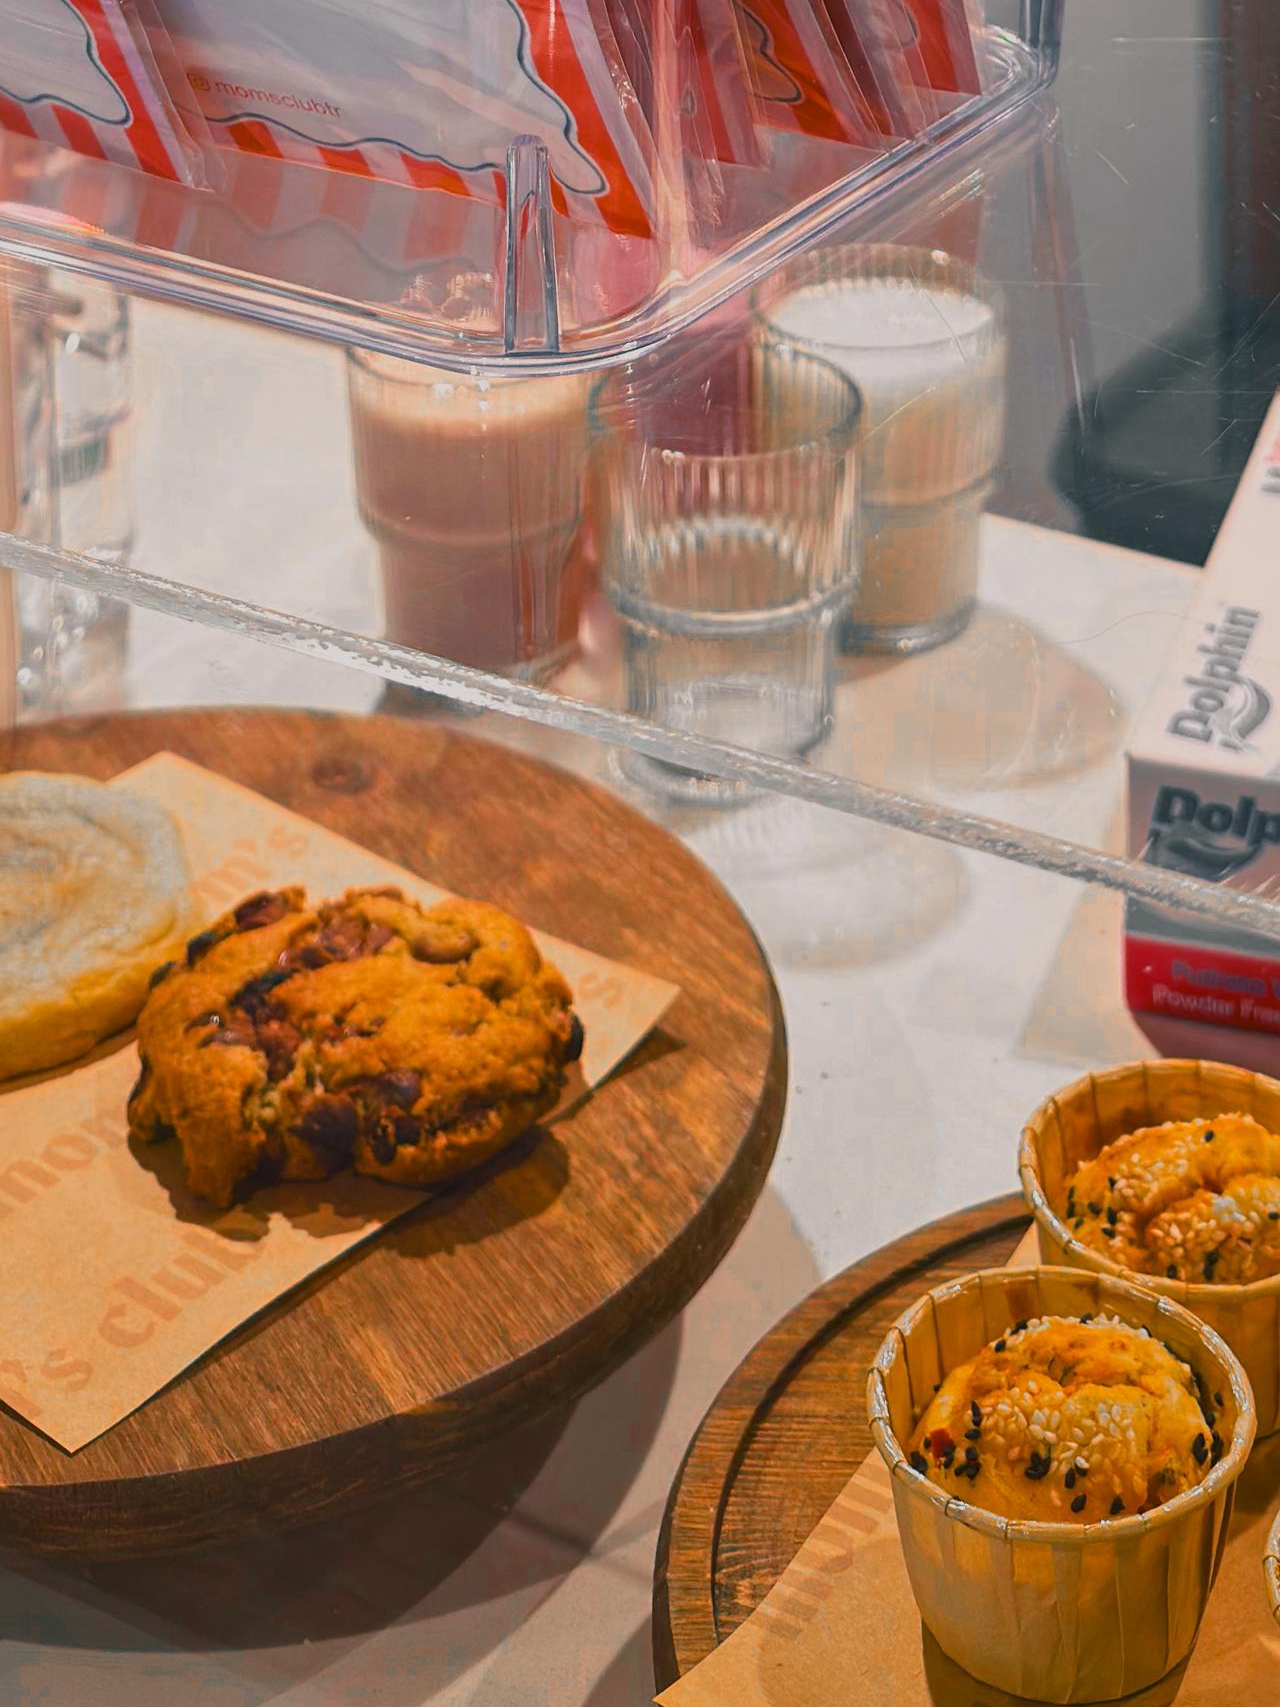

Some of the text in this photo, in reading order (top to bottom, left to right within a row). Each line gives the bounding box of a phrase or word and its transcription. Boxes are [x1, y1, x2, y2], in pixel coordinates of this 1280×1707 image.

[215, 80, 342, 118] momsclubtr
[1170, 604, 1261, 742] Dolphin
[1152, 983, 1235, 1018] Powder
